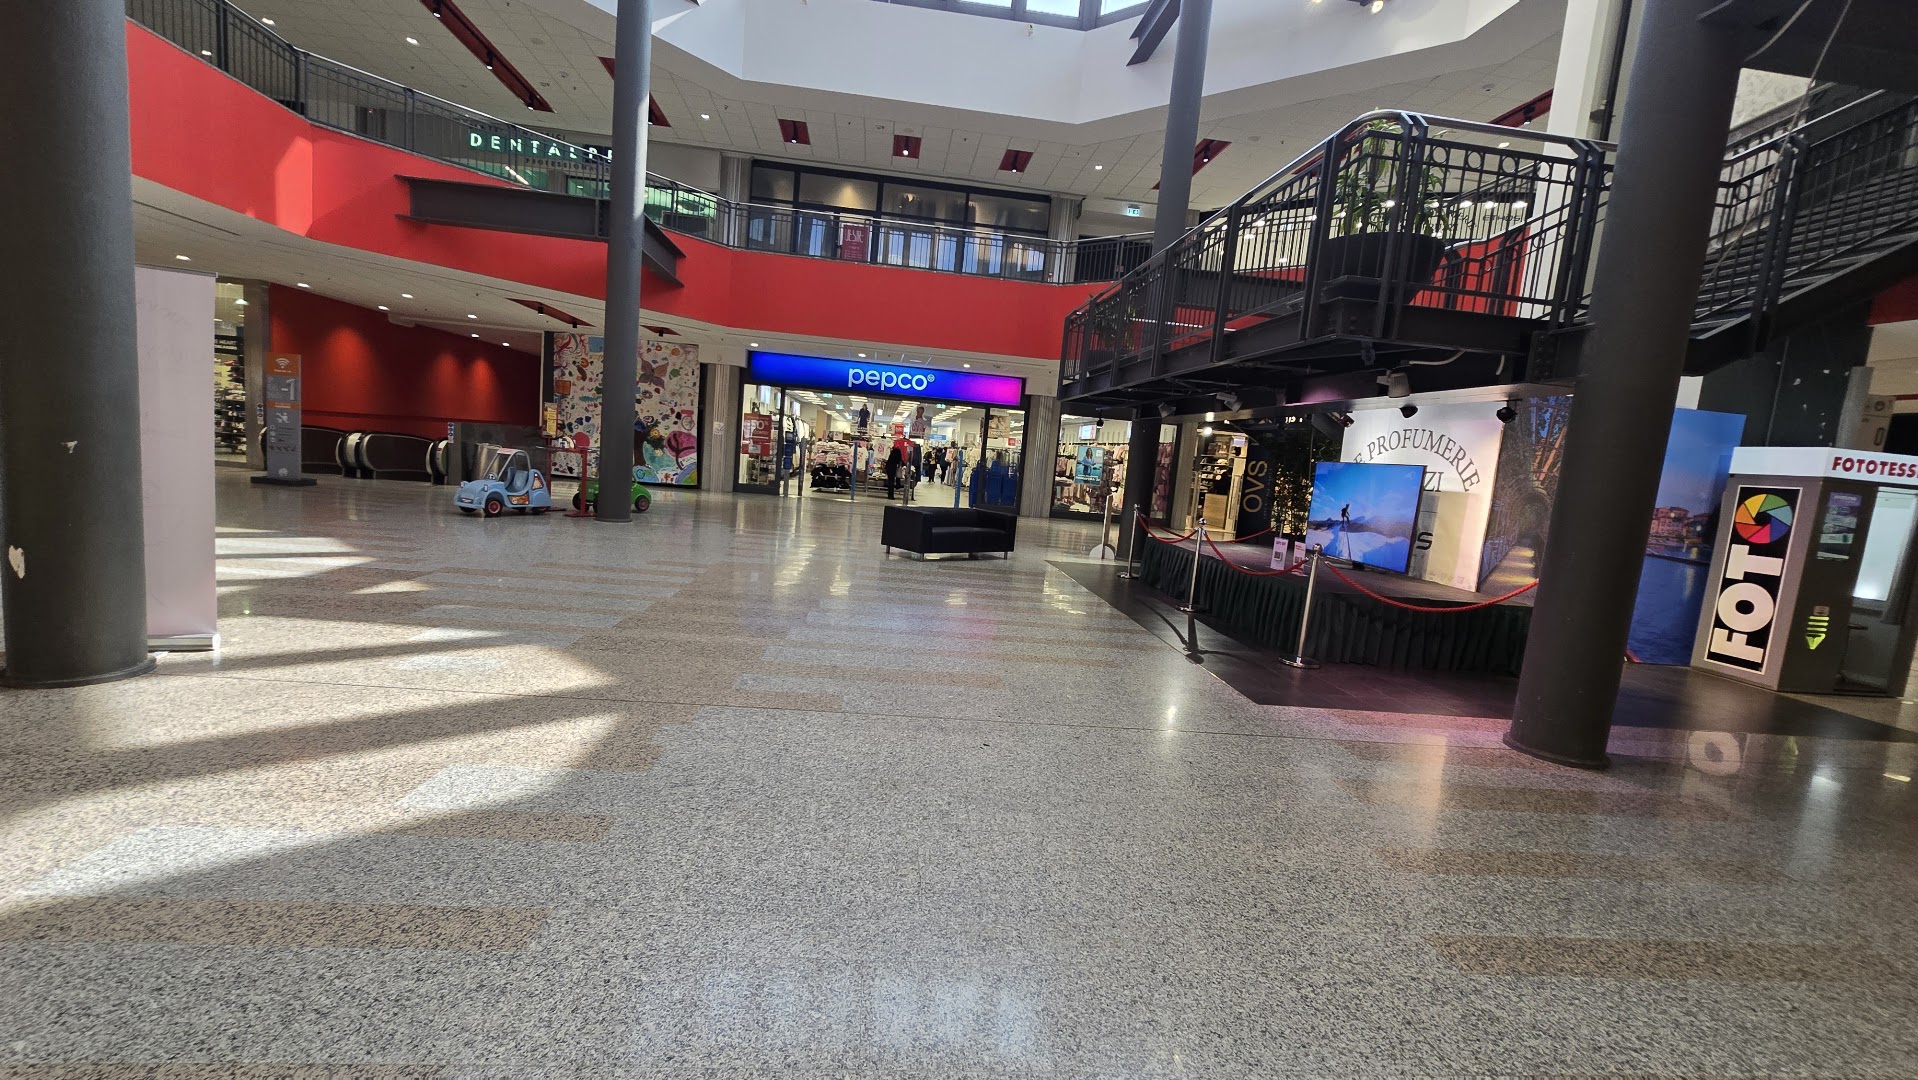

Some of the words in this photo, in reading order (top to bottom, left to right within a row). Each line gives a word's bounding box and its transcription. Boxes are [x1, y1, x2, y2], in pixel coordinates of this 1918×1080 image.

[1243, 460, 1268, 513] OVS
[1366, 428, 1481, 492] PROFUMERIE
[1831, 456, 1918, 478] FOTOTESS
